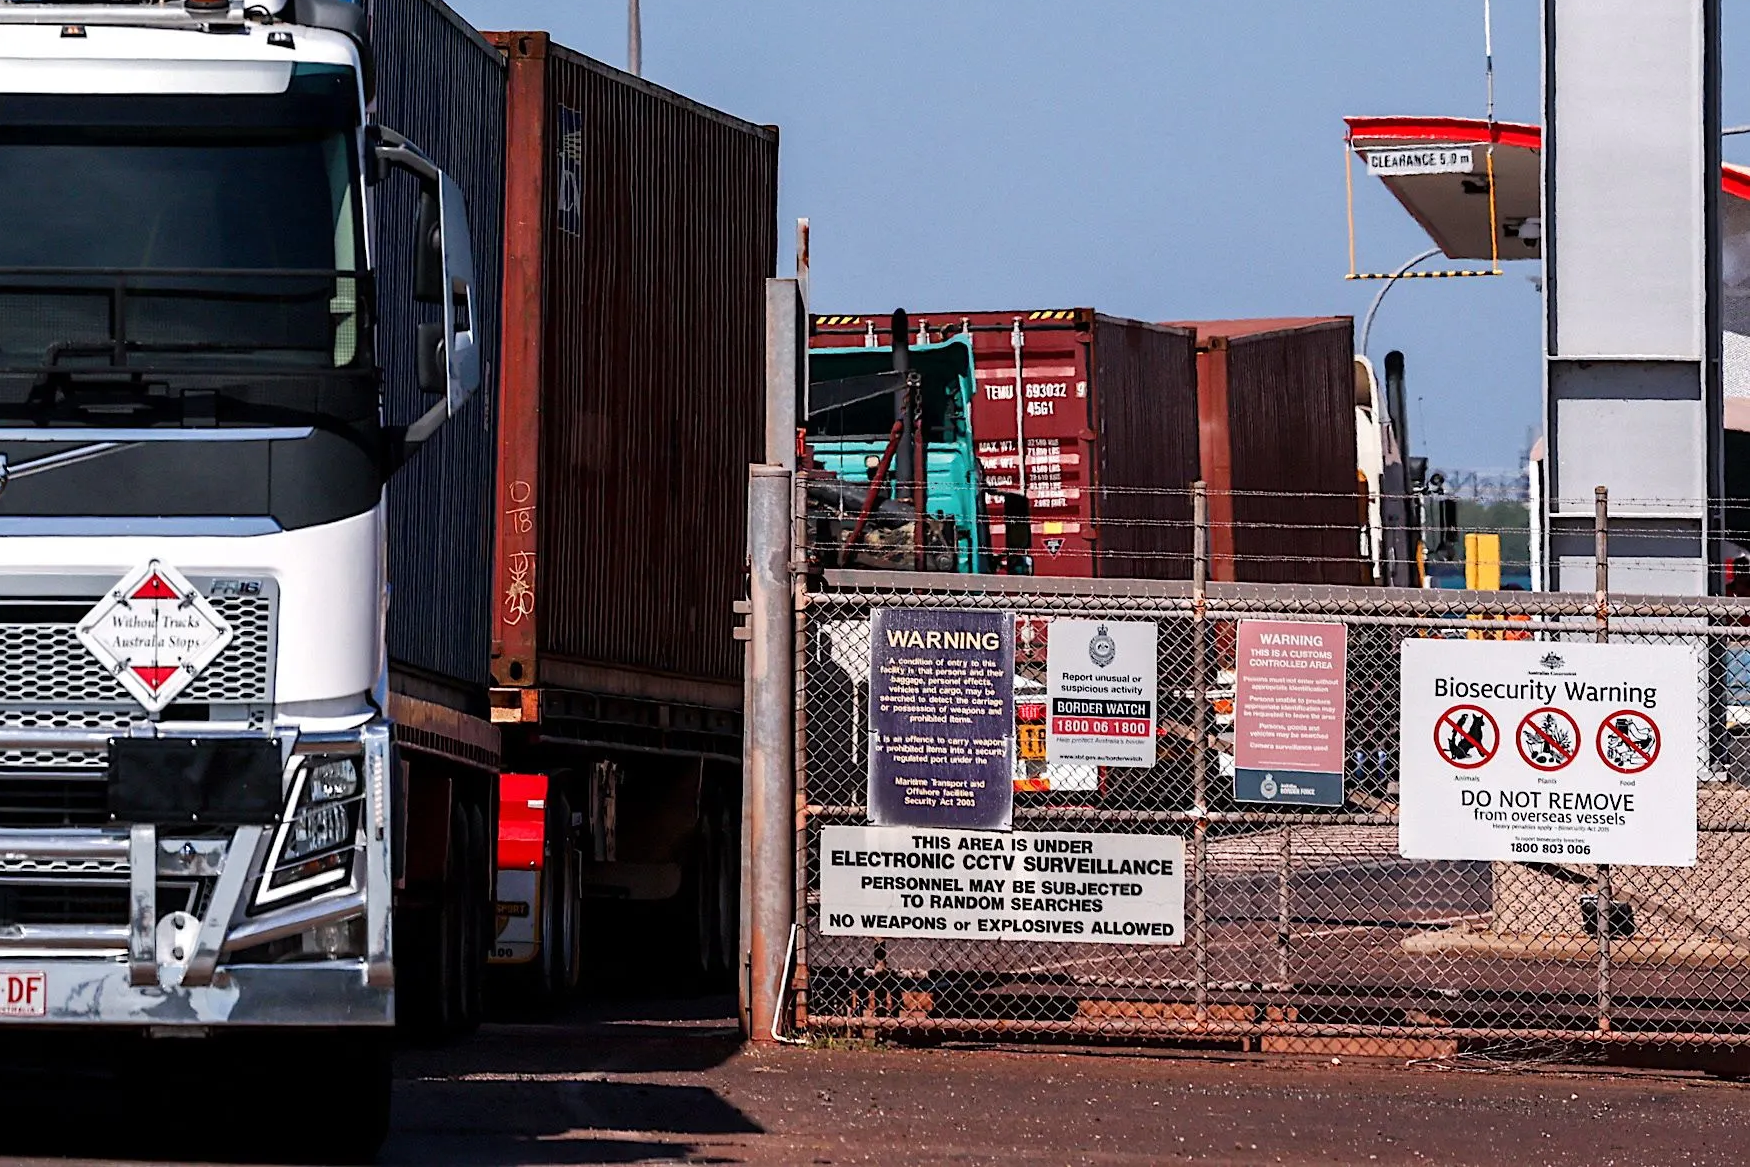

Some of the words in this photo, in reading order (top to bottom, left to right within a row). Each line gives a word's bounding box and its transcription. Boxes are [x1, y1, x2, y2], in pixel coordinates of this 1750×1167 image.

[1371, 153, 1437, 168] CLEARANCE
[1460, 155, 1469, 164] m
[985, 384, 1014, 400] TEMU
[1026, 383, 1067, 399] 693032
[1027, 401, 1054, 416] 45G1
[113, 615, 157, 628] Withou
[162, 615, 200, 628] Trucks
[168, 635, 200, 652] Stops
[887, 630, 1000, 651] WARNING
[1260, 633, 1323, 647] WARNING
[1250, 649, 1270, 657] THIS
[1272, 649, 1280, 657] IS
[1290, 650, 1333, 659] CUSTOMS
[898, 658, 932, 666] condition
[935, 658, 944, 666] of
[947, 659, 968, 668] entry
[982, 660, 996, 668] this
[1249, 659, 1307, 669] CONTROLLED
[1309, 660, 1333, 670] AREA
[880, 666, 905, 675] facility
[908, 666, 915, 674] is
[918, 666, 933, 675] that
[935, 668, 966, 677] persons
[969, 668, 984, 676] and
[987, 668, 1004, 677] their
[1062, 672, 1093, 683] Report
[1095, 674, 1130, 683] unusual
[890, 676, 926, 685] baggage,
[963, 677, 994, 687] effects,
[889, 685, 919, 694] vehicles
[922, 686, 936, 694] and
[939, 687, 963, 696] cargo,
[965, 688, 982, 697] may
[985, 687, 995, 696] be
[1061, 684, 1109, 694] suspicious
[1111, 684, 1143, 695] activity
[1434, 677, 1557, 705] Biosecurity
[1565, 681, 1658, 709] Warning
[880, 695, 915, 703] searched
[928, 695, 953, 704] detect
[956, 696, 969, 705] the
[971, 697, 1004, 706] carriage
[893, 704, 936, 713] possession
[939, 705, 947, 713] of
[950, 707, 985, 715] weapons
[988, 707, 1003, 716] and
[1057, 700, 1102, 715] BORDER
[1105, 702, 1146, 716] WATCH
[910, 714, 947, 723] prohibited
[949, 714, 973, 724] items.
[1057, 720, 1089, 732] 1800
[1093, 721, 1108, 732] 06
[1113, 722, 1146, 734] 1800
[883, 735, 891, 743] is
[905, 735, 934, 744] offence
[937, 736, 945, 744] to
[948, 738, 970, 746] carry
[886, 744, 924, 754] prohibited
[926, 745, 948, 754] items
[950, 746, 965, 755] into
[975, 748, 1007, 758] security
[893, 755, 928, 764] regulated
[930, 756, 948, 765] port
[950, 756, 973, 764] under
[975, 757, 988, 765] the
[895, 777, 928, 786] Maritime
[931, 778, 968, 788] Transport
[970, 780, 985, 789] and
[1537, 777, 1557, 785] Plants
[906, 787, 940, 797] Offshore
[904, 797, 937, 807] Security
[940, 797, 953, 806] Act
[956, 798, 975, 807] 2003
[1461, 790, 1492, 807] DO
[1499, 790, 1542, 809] NOT
[1549, 792, 1635, 812] REMOVE
[1474, 808, 1507, 821] from
[1512, 810, 1572, 824] overseas
[1576, 812, 1626, 826] vessels
[911, 836, 951, 850] THIS
[957, 837, 1004, 851] AREA
[1011, 838, 1028, 852] IS
[1034, 839, 1093, 854] UNDER
[1511, 843, 1538, 853] 1800
[1542, 844, 1564, 854] 803
[1567, 844, 1591, 855] 006
[831, 850, 955, 870] ELECTRONIC
[962, 854, 1015, 871] CCTV
[1023, 855, 1173, 876] SURVEILLANCE
[861, 876, 964, 892] PERSONNEL
[969, 878, 1006, 893] MAY
[1012, 880, 1035, 894] BE
[1041, 881, 1143, 896] SUBJECTED
[901, 894, 923, 908] TO
[930, 895, 1005, 911] RANDOM
[1011, 897, 1103, 913] SEARCHES
[829, 913, 854, 928] NO
[861, 914, 947, 930] WEAPONS
[953, 920, 971, 931] or
[977, 919, 1084, 935] EXPLOSIVES
[1091, 922, 1174, 936] ALLOWED
